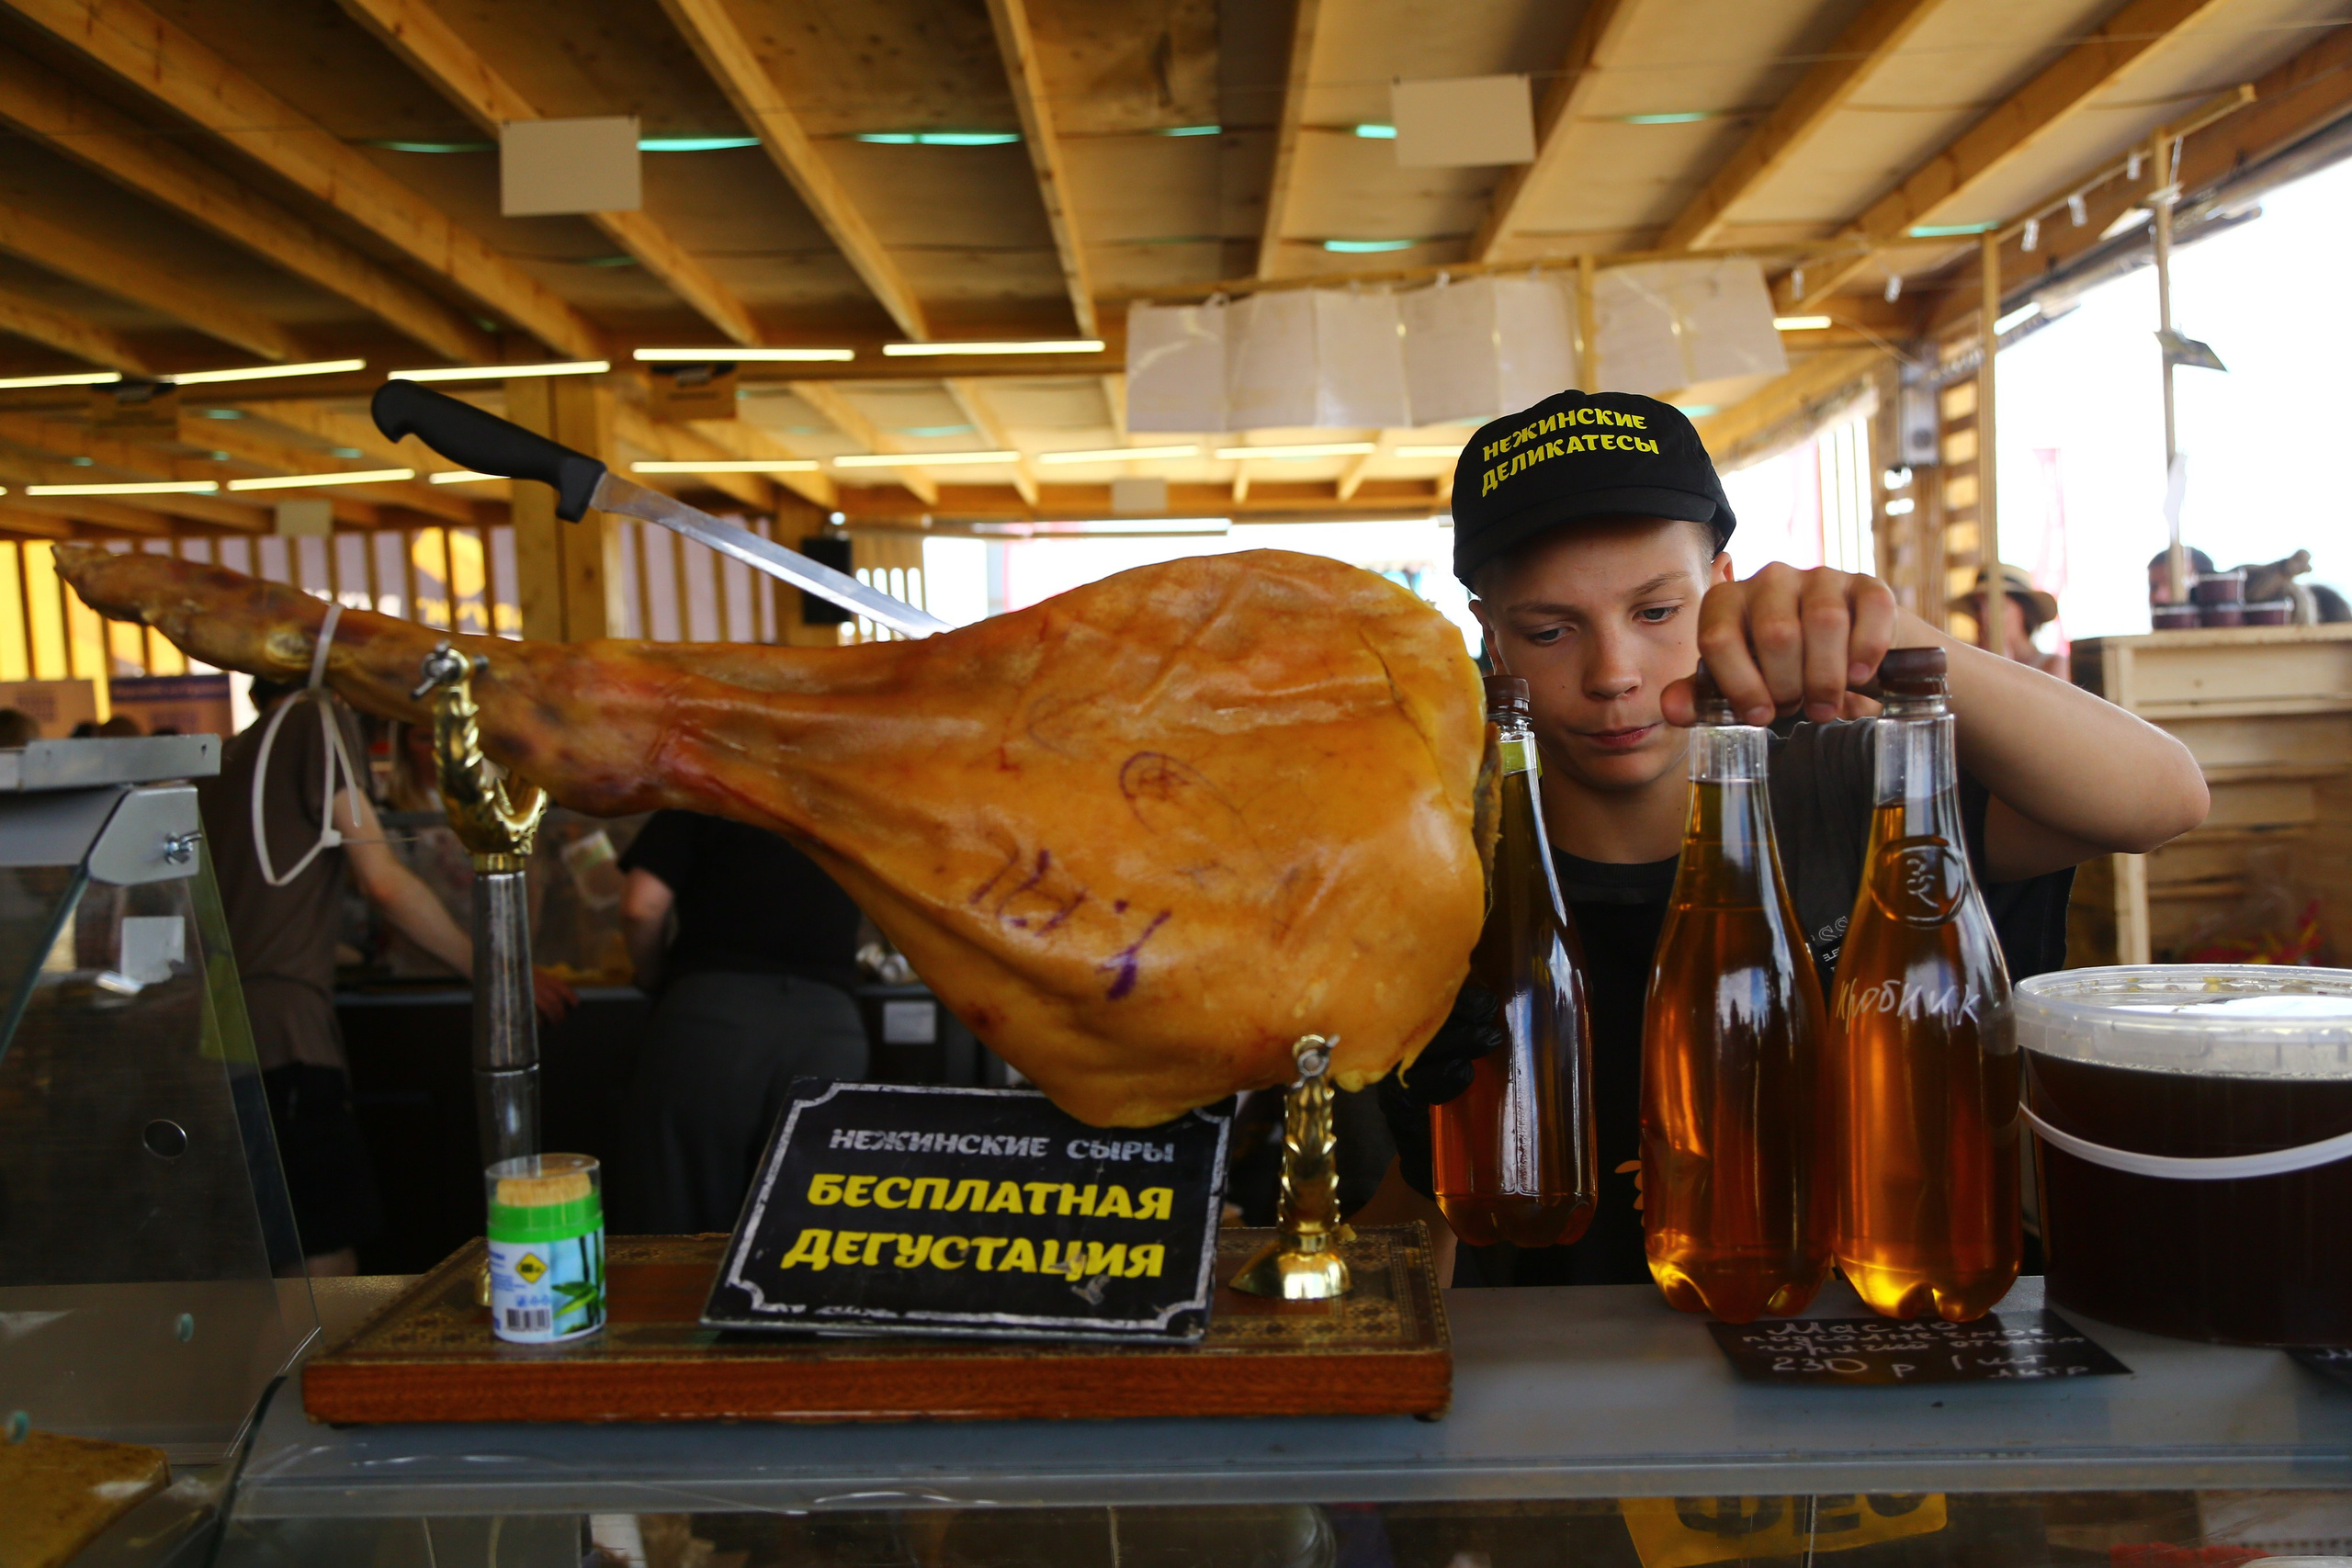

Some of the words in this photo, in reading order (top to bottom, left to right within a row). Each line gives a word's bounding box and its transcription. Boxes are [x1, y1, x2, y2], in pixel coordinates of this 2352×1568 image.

[1481, 407, 1648, 462] НЕЖИНСКИЕ
[1481, 434, 1660, 497] ДЕЛИКАТЕСЫ
[829, 1128, 1049, 1156] НЕЖИНСКИЕ
[1066, 1140, 1175, 1163] СЫРЫ
[807, 1172, 1174, 1221] БЕСПЛАТНАЯ
[779, 1227, 1166, 1282] ДЕГУСТАЦИЯ
[1771, 1356, 1869, 1373] 230
